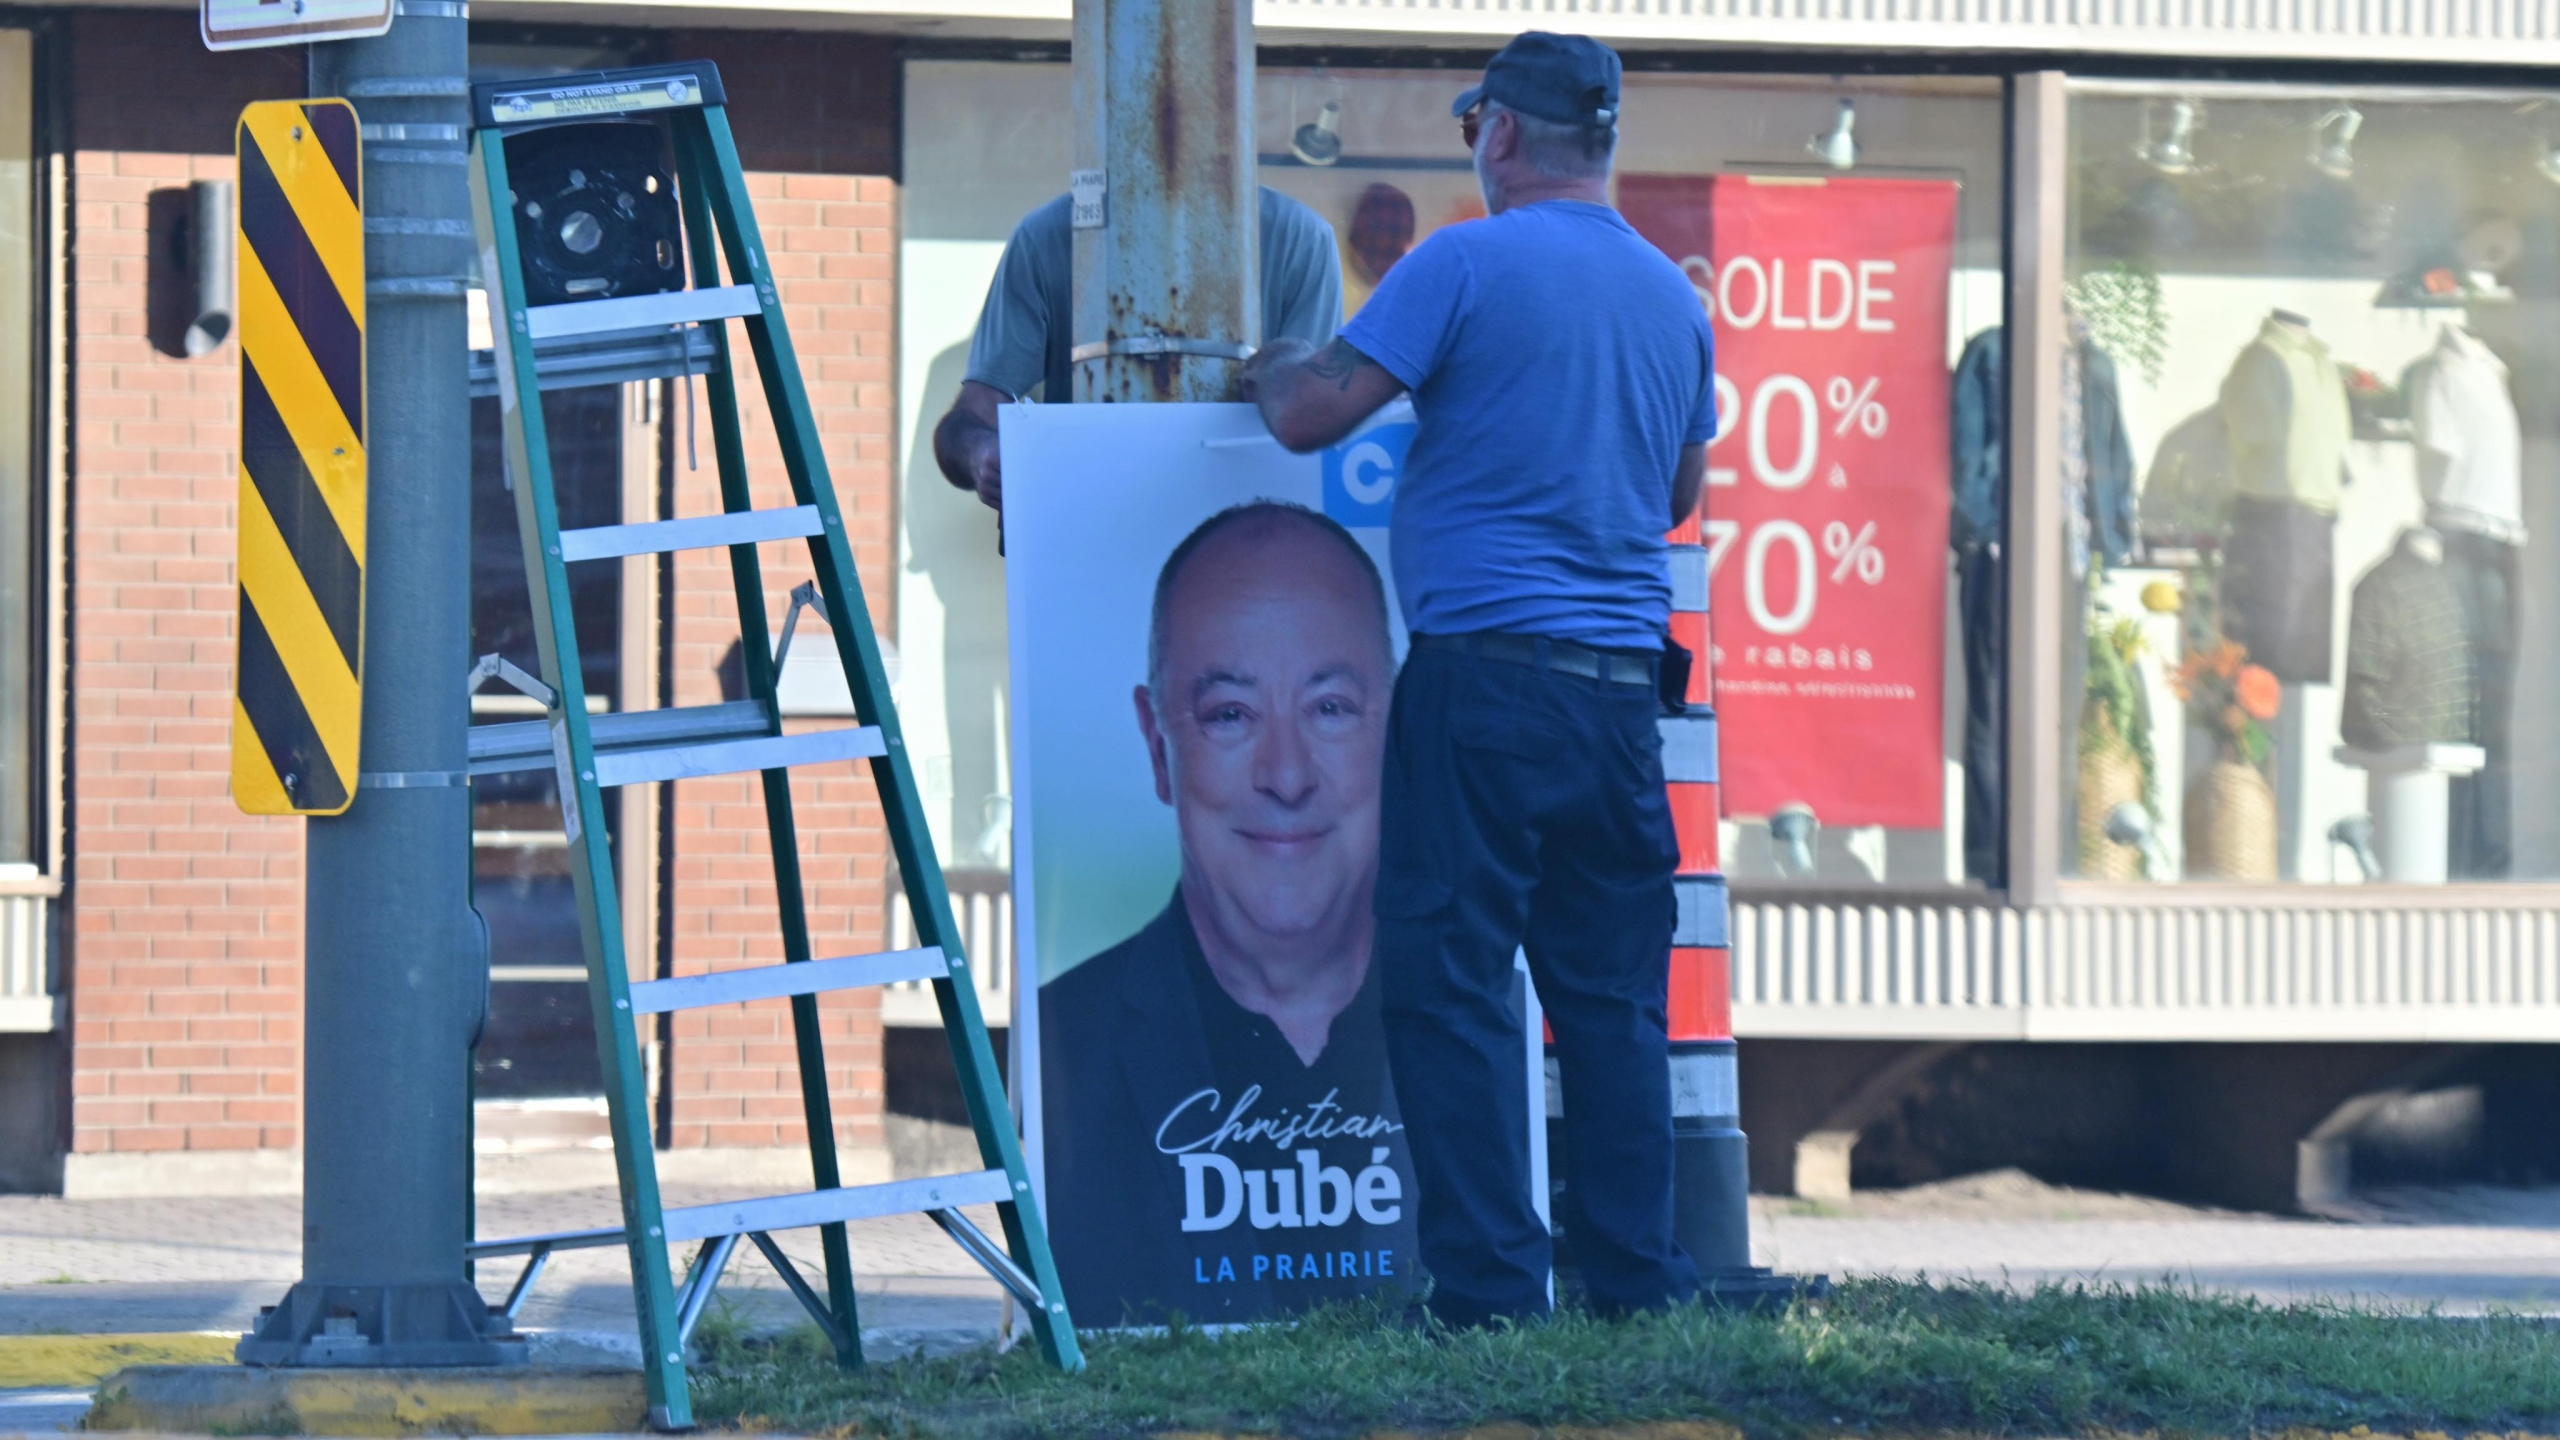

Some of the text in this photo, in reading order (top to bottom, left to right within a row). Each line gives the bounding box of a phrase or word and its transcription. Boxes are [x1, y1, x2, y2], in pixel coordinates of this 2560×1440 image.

[551, 91, 565, 99] DO
[565, 90, 584, 98] NOT
[586, 87, 614, 96] STAND
[1679, 256, 1896, 332] SOLDE
[1341, 441, 1395, 505] C
[1745, 642, 1873, 671] rabais
[1156, 1085, 1404, 1154] Christian
[1179, 1147, 1402, 1232] Dubé
[1195, 1250, 1394, 1283] LA PRAIRIE
